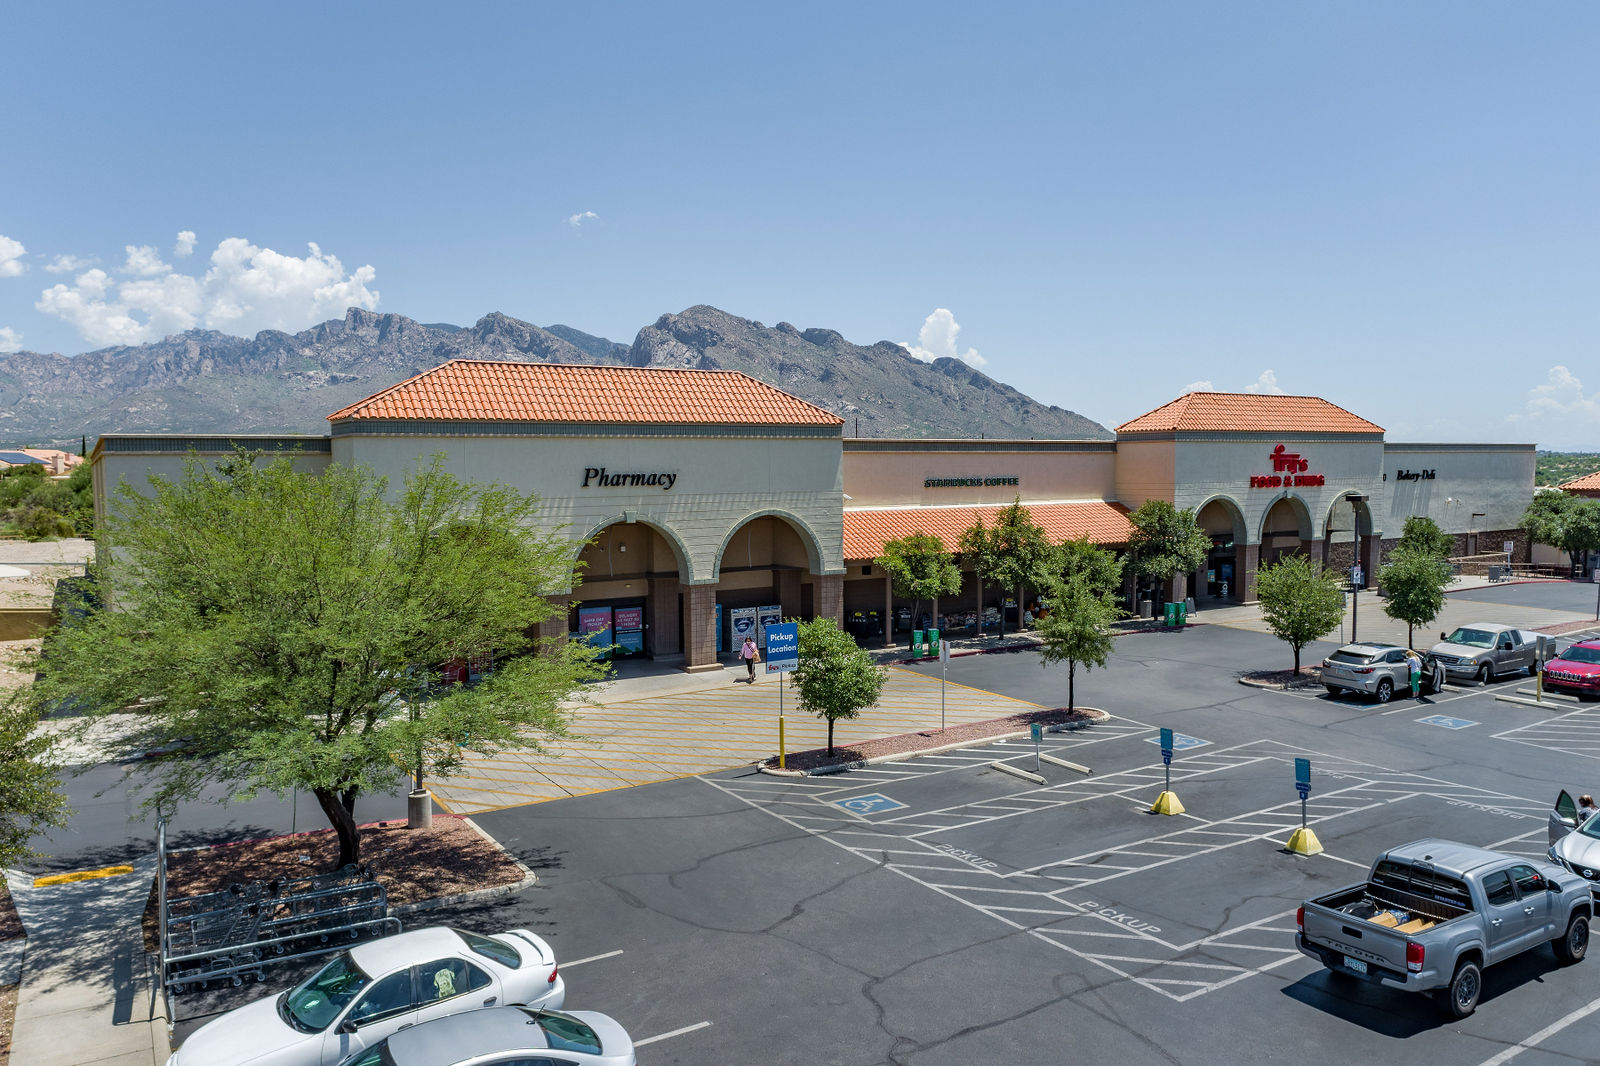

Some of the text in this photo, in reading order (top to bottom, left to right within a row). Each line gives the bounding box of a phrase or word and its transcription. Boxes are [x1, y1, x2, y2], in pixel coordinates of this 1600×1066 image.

[581, 467, 677, 490] Pharmacy
[924, 477, 1019, 488] STARBUCKS COFFEE
[1250, 475, 1282, 488] FOOD
[1283, 475, 1293, 487] &
[770, 633, 794, 642] Pickup
[768, 644, 797, 654] Location
[935, 843, 998, 868] PICKUP
[1078, 900, 1162, 933] PICKUP
[1327, 940, 1385, 963] TACOMA
